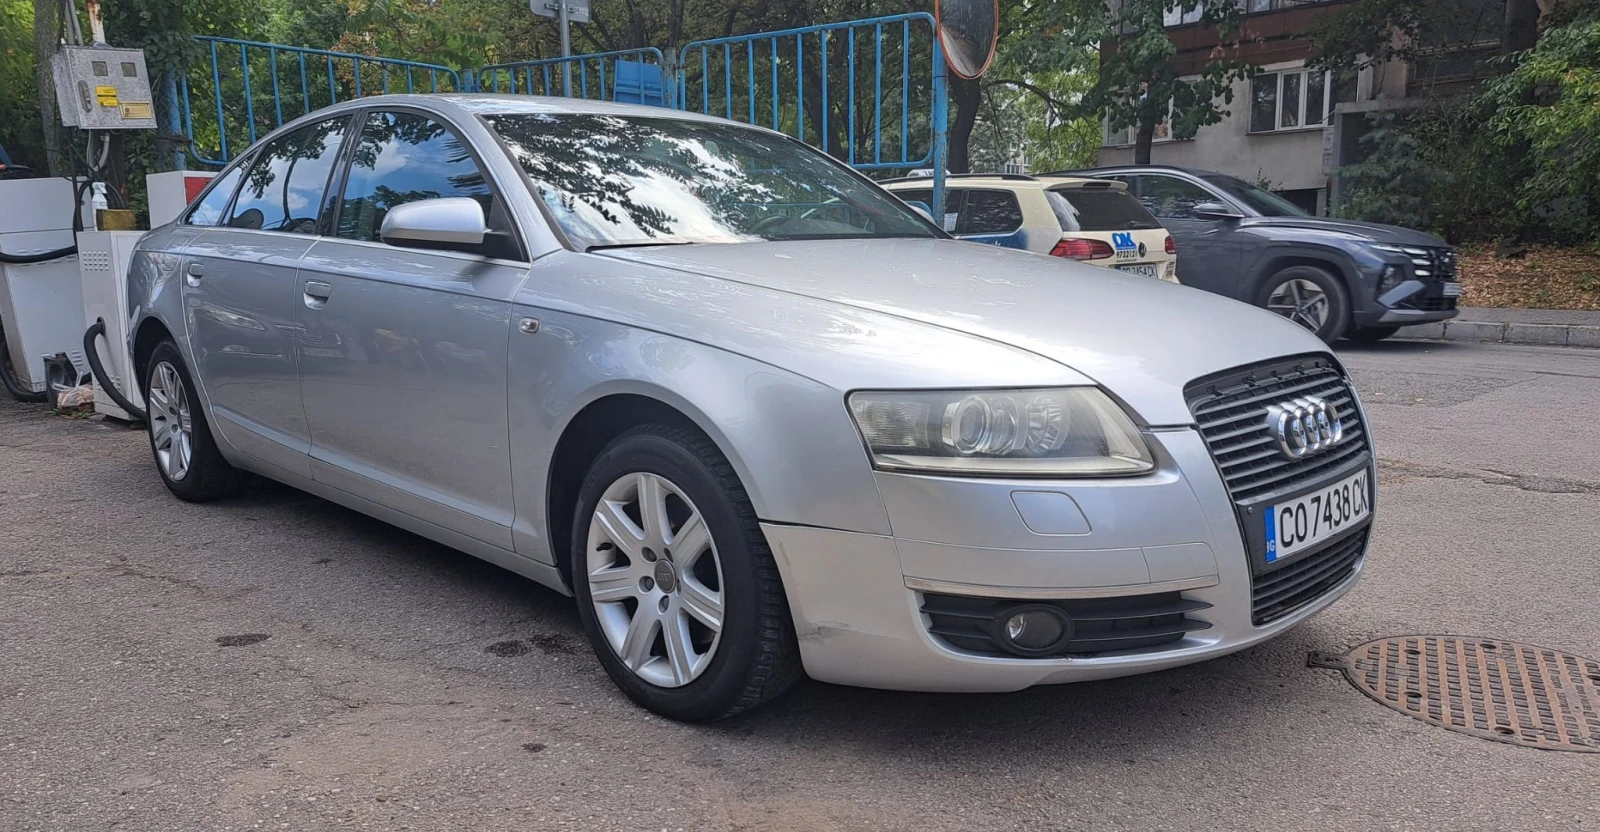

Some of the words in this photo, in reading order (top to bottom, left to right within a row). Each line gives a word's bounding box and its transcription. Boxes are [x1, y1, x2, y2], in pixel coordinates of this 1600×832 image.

[1112, 232, 1136, 247] OK
[1280, 502, 1308, 547] CO
[1311, 484, 1351, 537] 7438
[1353, 474, 1368, 516] CK
